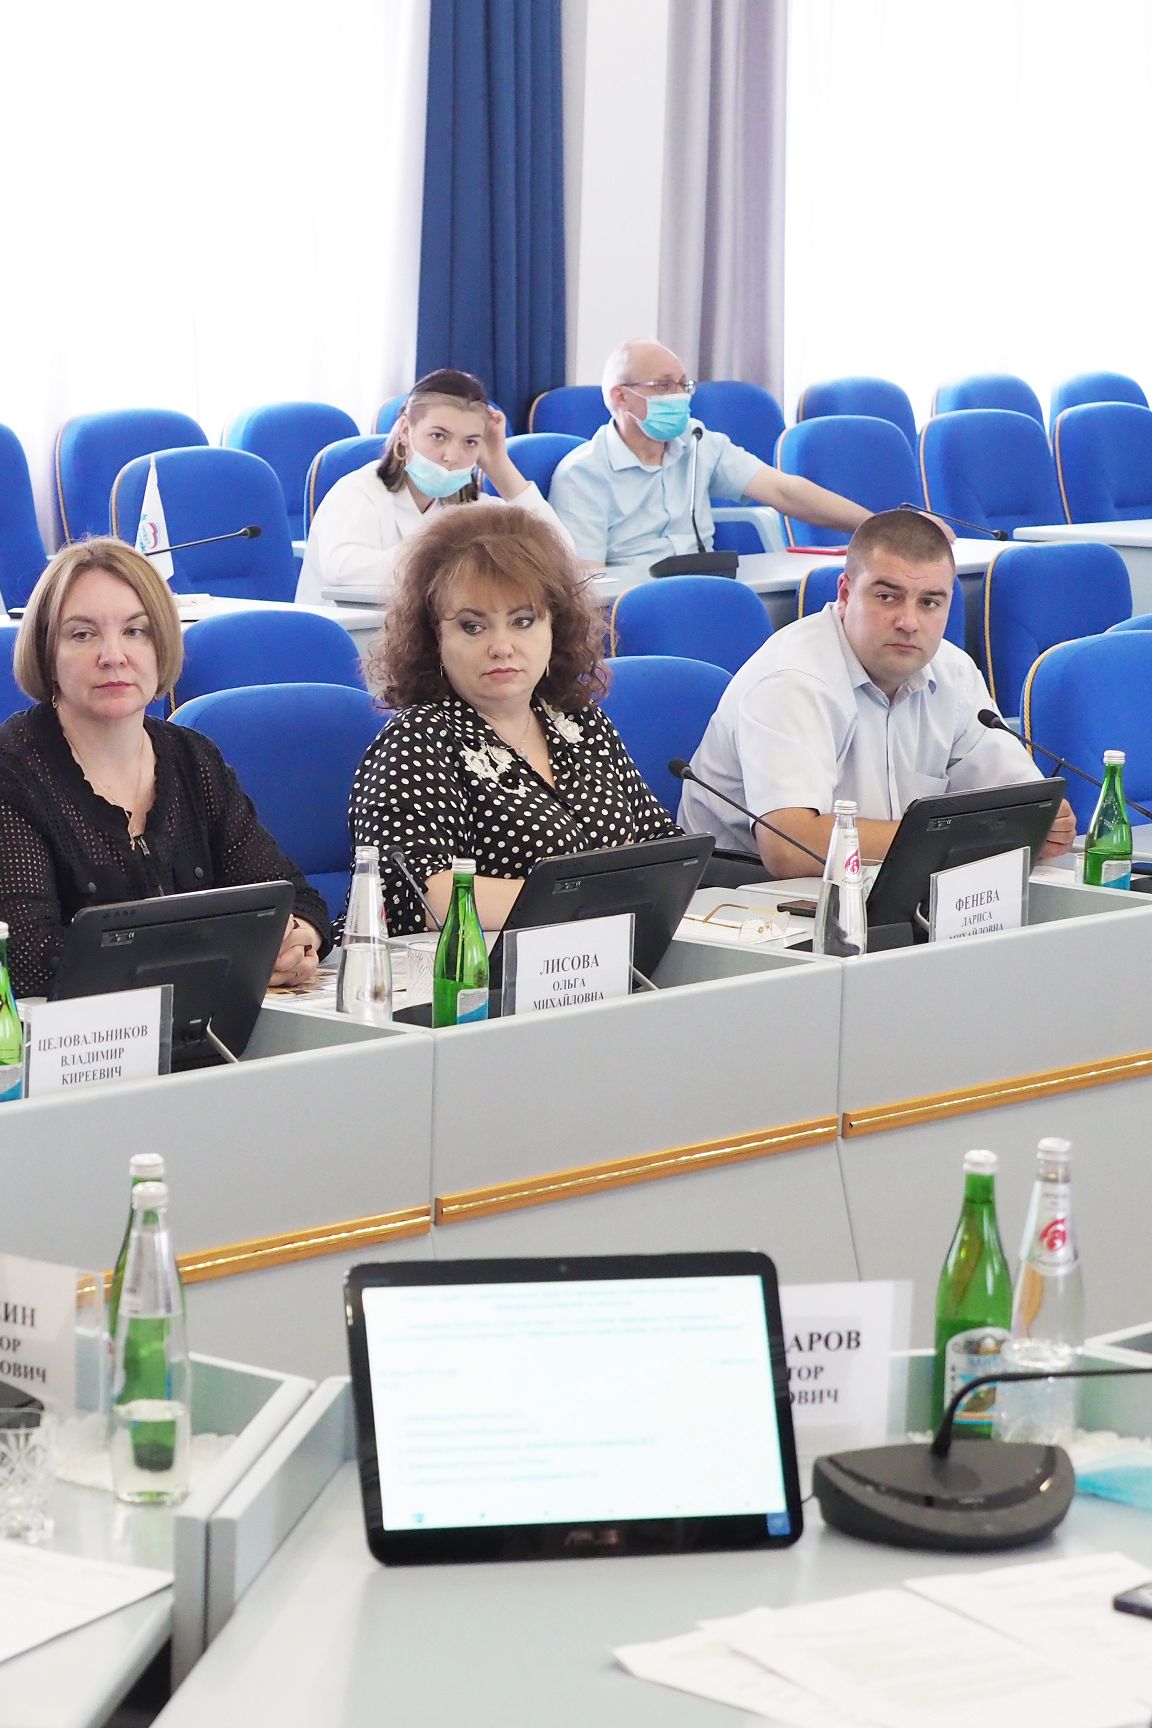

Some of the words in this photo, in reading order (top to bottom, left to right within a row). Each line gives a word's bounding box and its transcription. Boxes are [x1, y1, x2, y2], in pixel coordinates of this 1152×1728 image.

[955, 888, 1000, 911] ФЕНЕВА
[961, 911, 993, 927] ЛАРИСА
[540, 953, 600, 975] ЛИСОВА
[552, 977, 586, 992] ОЛЬГА
[532, 992, 604, 1011] МИХАЙЛОВНА
[38, 1025, 148, 1052] ЦЕЛОВАЛЬНИКОВ
[61, 1047, 125, 1067] ВЛАДИМИР
[62, 1066, 122, 1085] КИРЕЕВИЧ
[787, 1330, 861, 1353] АРОВ
[788, 1365, 824, 1381] ТОР
